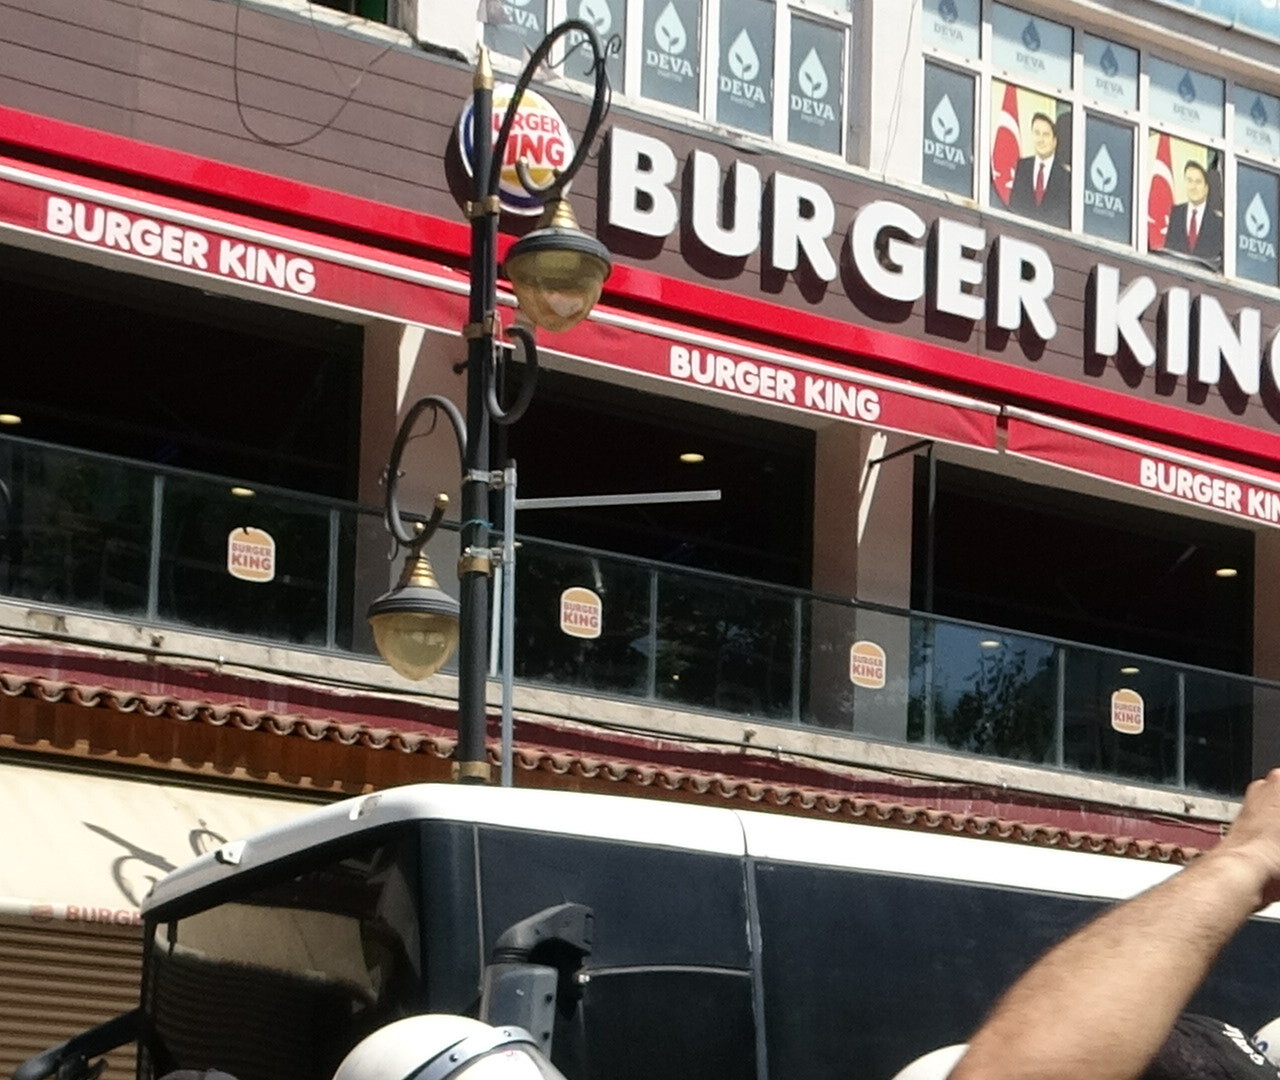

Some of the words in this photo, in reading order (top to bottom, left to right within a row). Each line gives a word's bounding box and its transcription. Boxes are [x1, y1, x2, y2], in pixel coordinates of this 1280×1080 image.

[646, 50, 693, 77] DEVA
[720, 75, 766, 103] DEVA
[791, 94, 835, 121] DEVA
[492, 134, 565, 167] ING
[924, 138, 965, 165] DEVA
[1084, 190, 1124, 213] DEVA
[47, 196, 209, 270] BURGER
[220, 239, 316, 294] KING
[608, 126, 1058, 341] BURGER
[1239, 235, 1276, 258] DEVA
[670, 345, 796, 403] BURGER
[804, 375, 880, 421] KING
[1140, 457, 1241, 512] BURGER
[231, 553, 271, 570] KING
[564, 612, 598, 627] KING
[853, 663, 883, 678] KING
[1113, 712, 1141, 725] KING
